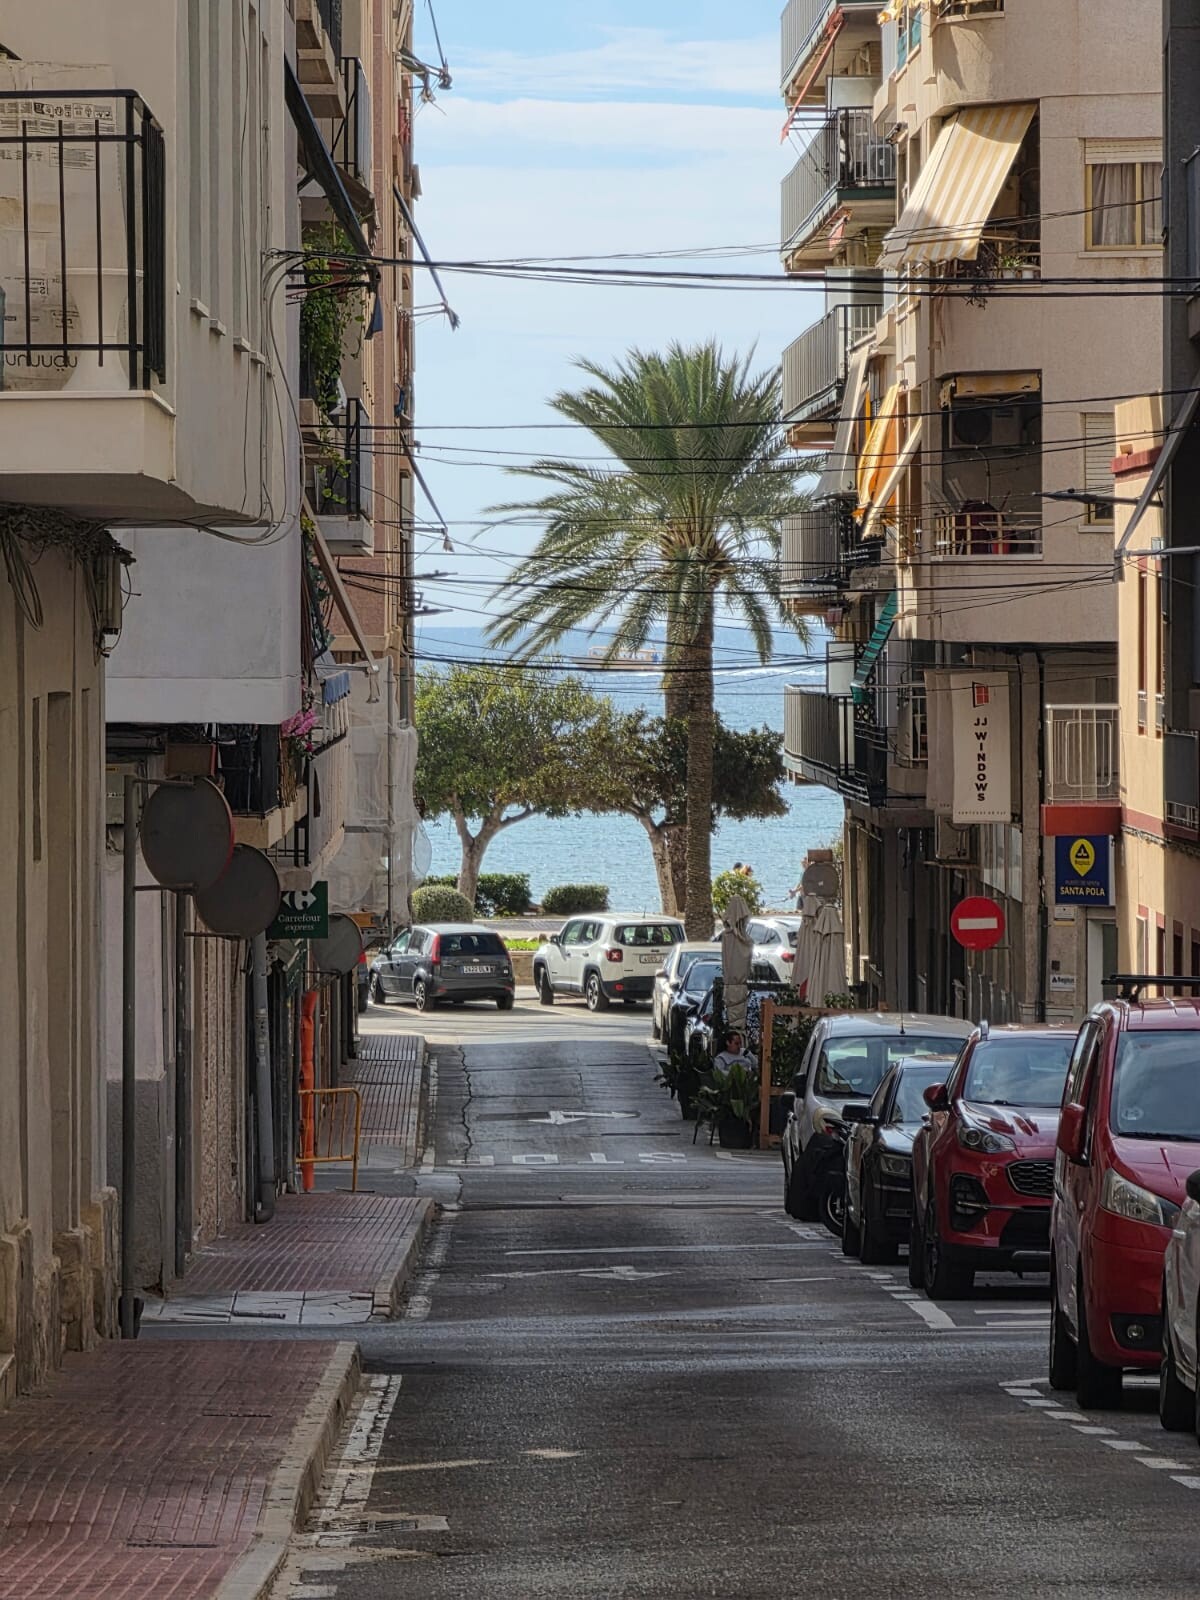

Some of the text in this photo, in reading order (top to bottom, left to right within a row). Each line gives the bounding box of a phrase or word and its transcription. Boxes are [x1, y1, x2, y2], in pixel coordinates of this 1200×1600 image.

[973, 717, 988, 801] JJ WINDOWS
[1060, 886, 1105, 897] SANTA POLA
[278, 913, 320, 923] Carrefour
[447, 1152, 688, 1166] STOP
